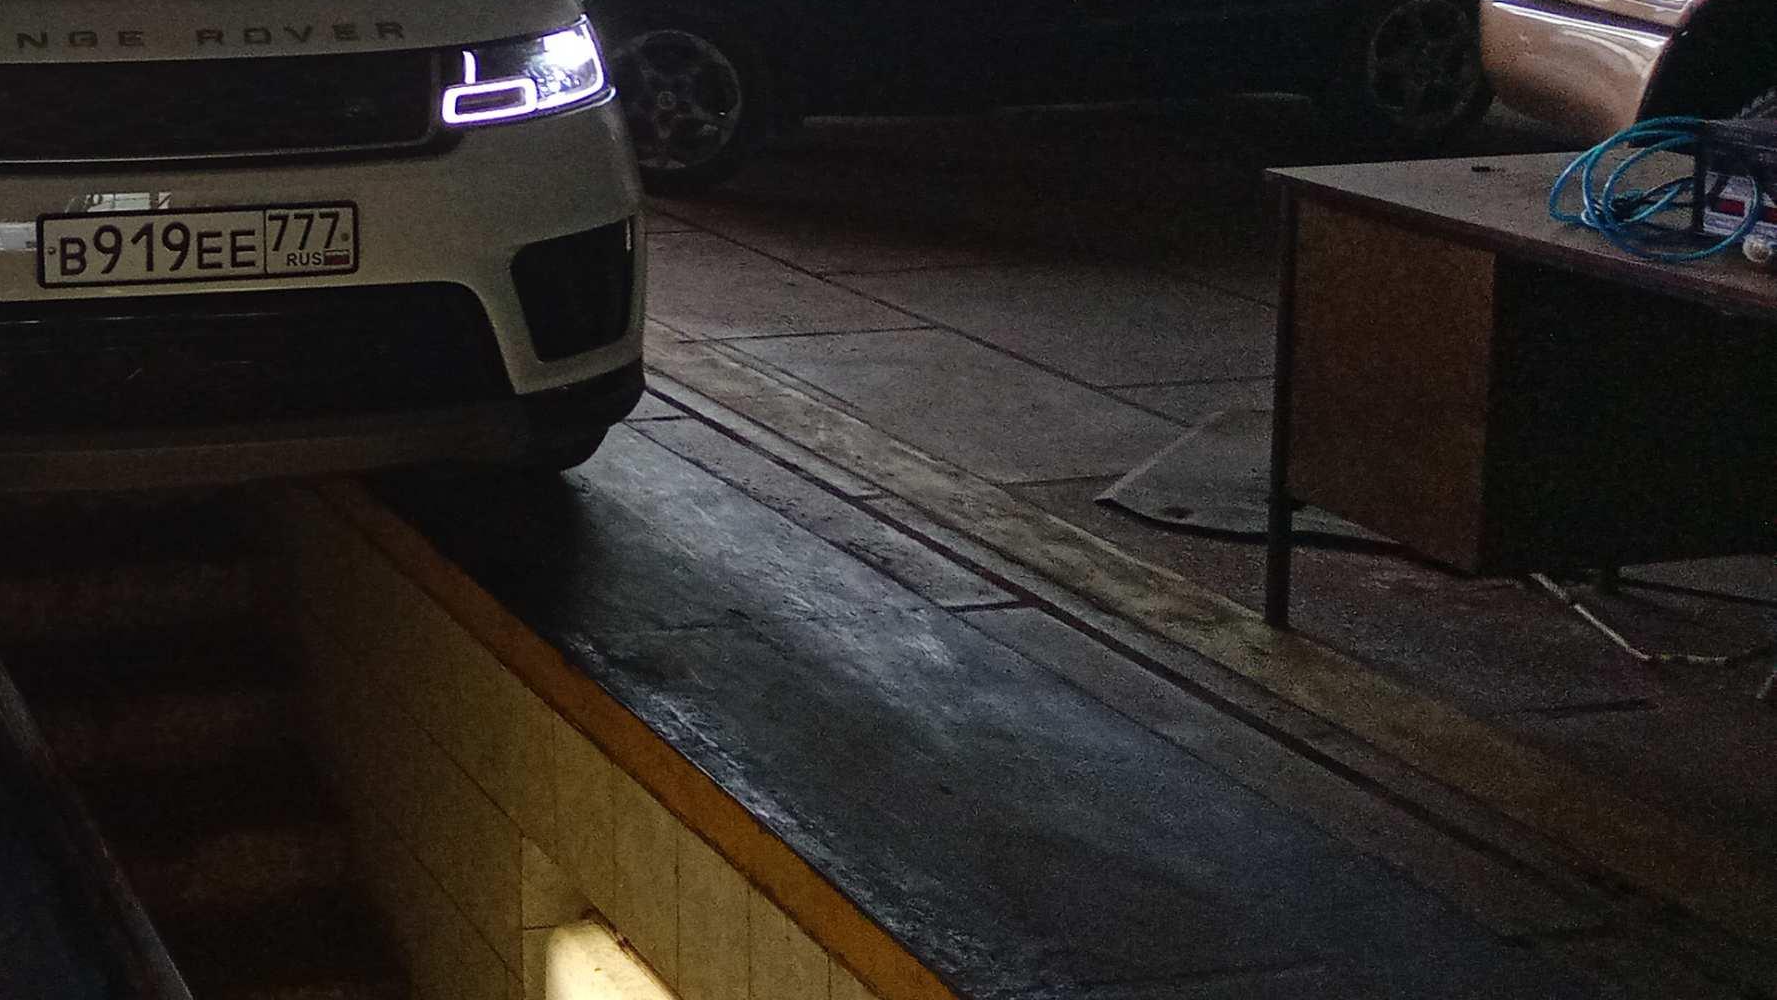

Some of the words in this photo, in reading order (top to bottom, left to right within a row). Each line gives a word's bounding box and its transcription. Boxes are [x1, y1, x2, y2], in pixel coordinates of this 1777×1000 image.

[195, 21, 407, 47] ROVER
[267, 211, 340, 252] 777
[286, 251, 323, 267] RUS
